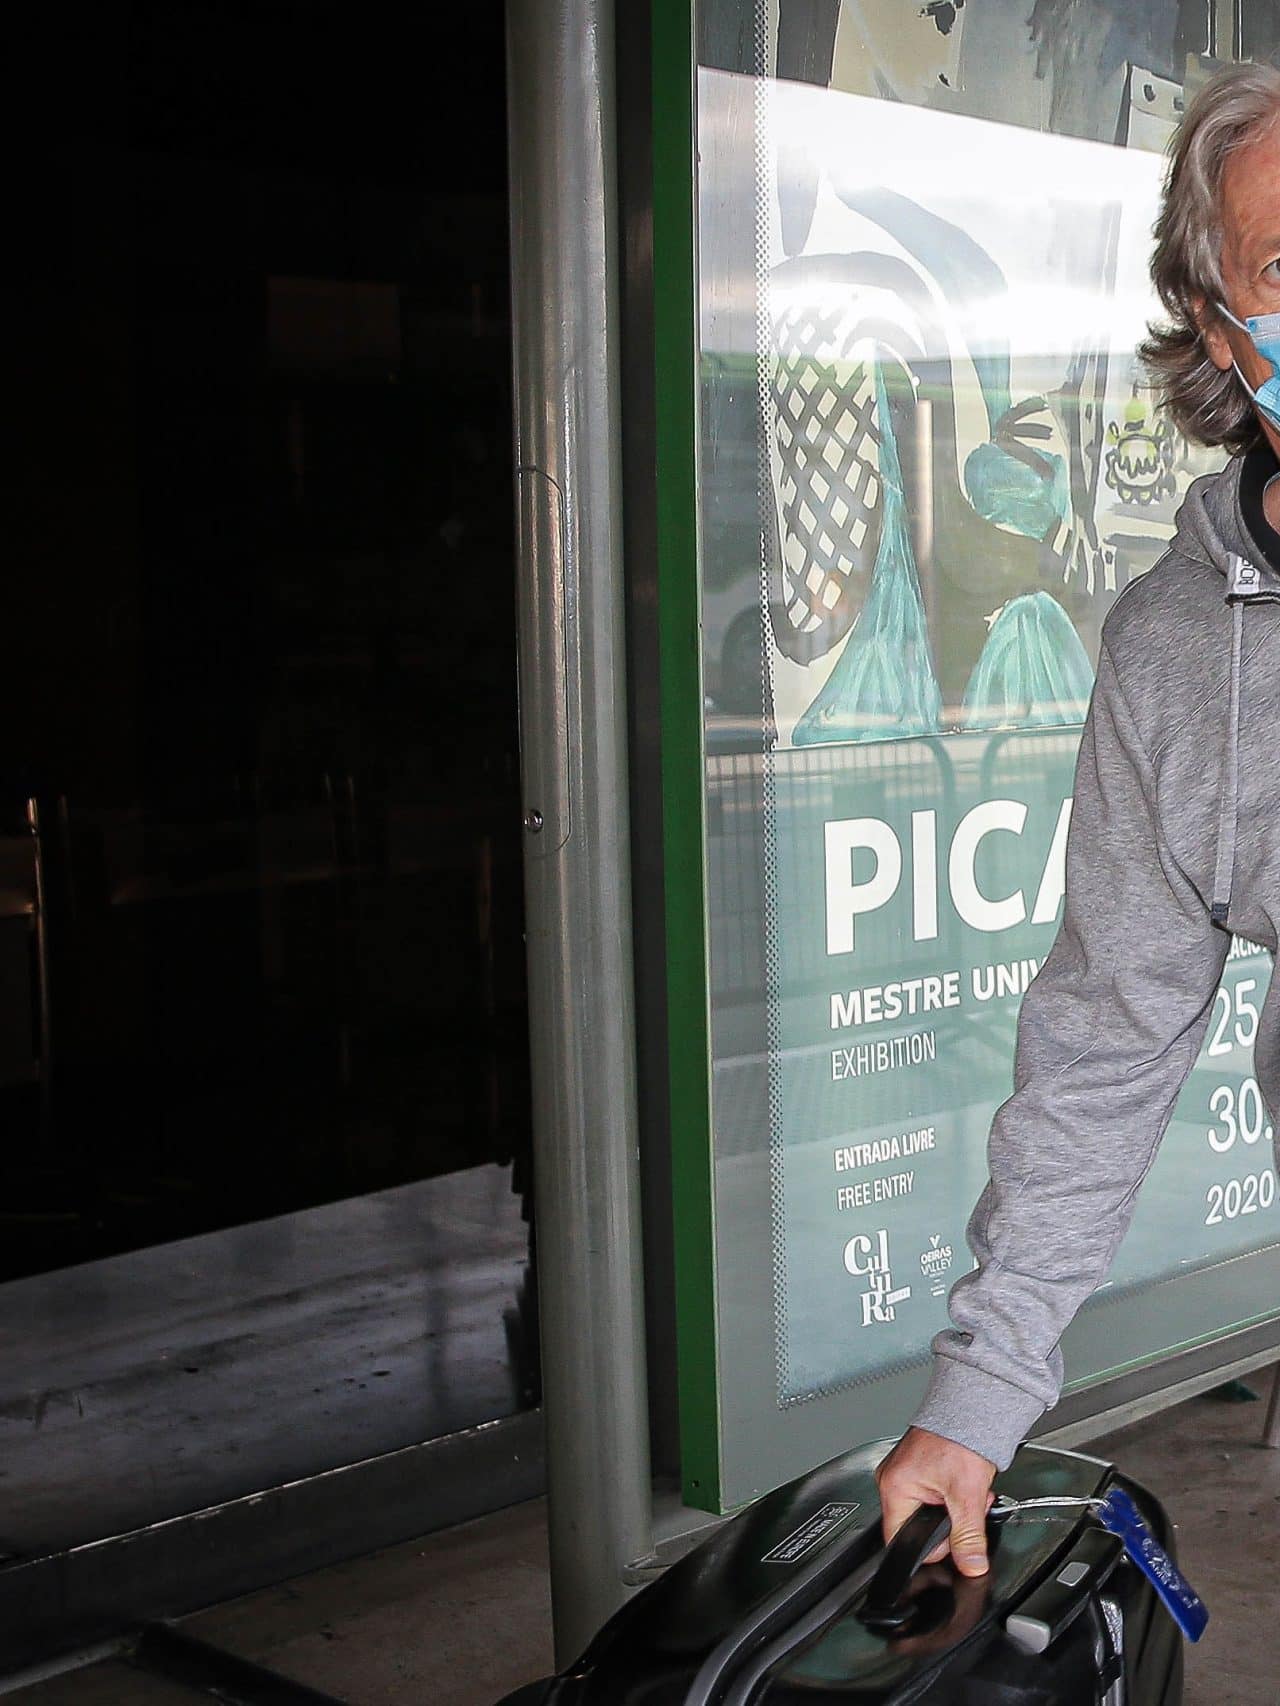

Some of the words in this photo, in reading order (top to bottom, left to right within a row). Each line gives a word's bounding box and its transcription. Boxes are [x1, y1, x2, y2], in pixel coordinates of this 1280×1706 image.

[830, 971, 961, 1029] MESTRE
[1208, 979, 1259, 1056] 25
[831, 1030, 937, 1081] EXHIBITION
[834, 1136, 901, 1172] ENTRADA
[902, 1127, 936, 1156] LIVRE
[837, 1182, 872, 1211] FREE
[873, 1170, 914, 1202] ENTRY
[1205, 1169, 1274, 1226] 2020
[920, 1246, 953, 1265] OEIRAS
